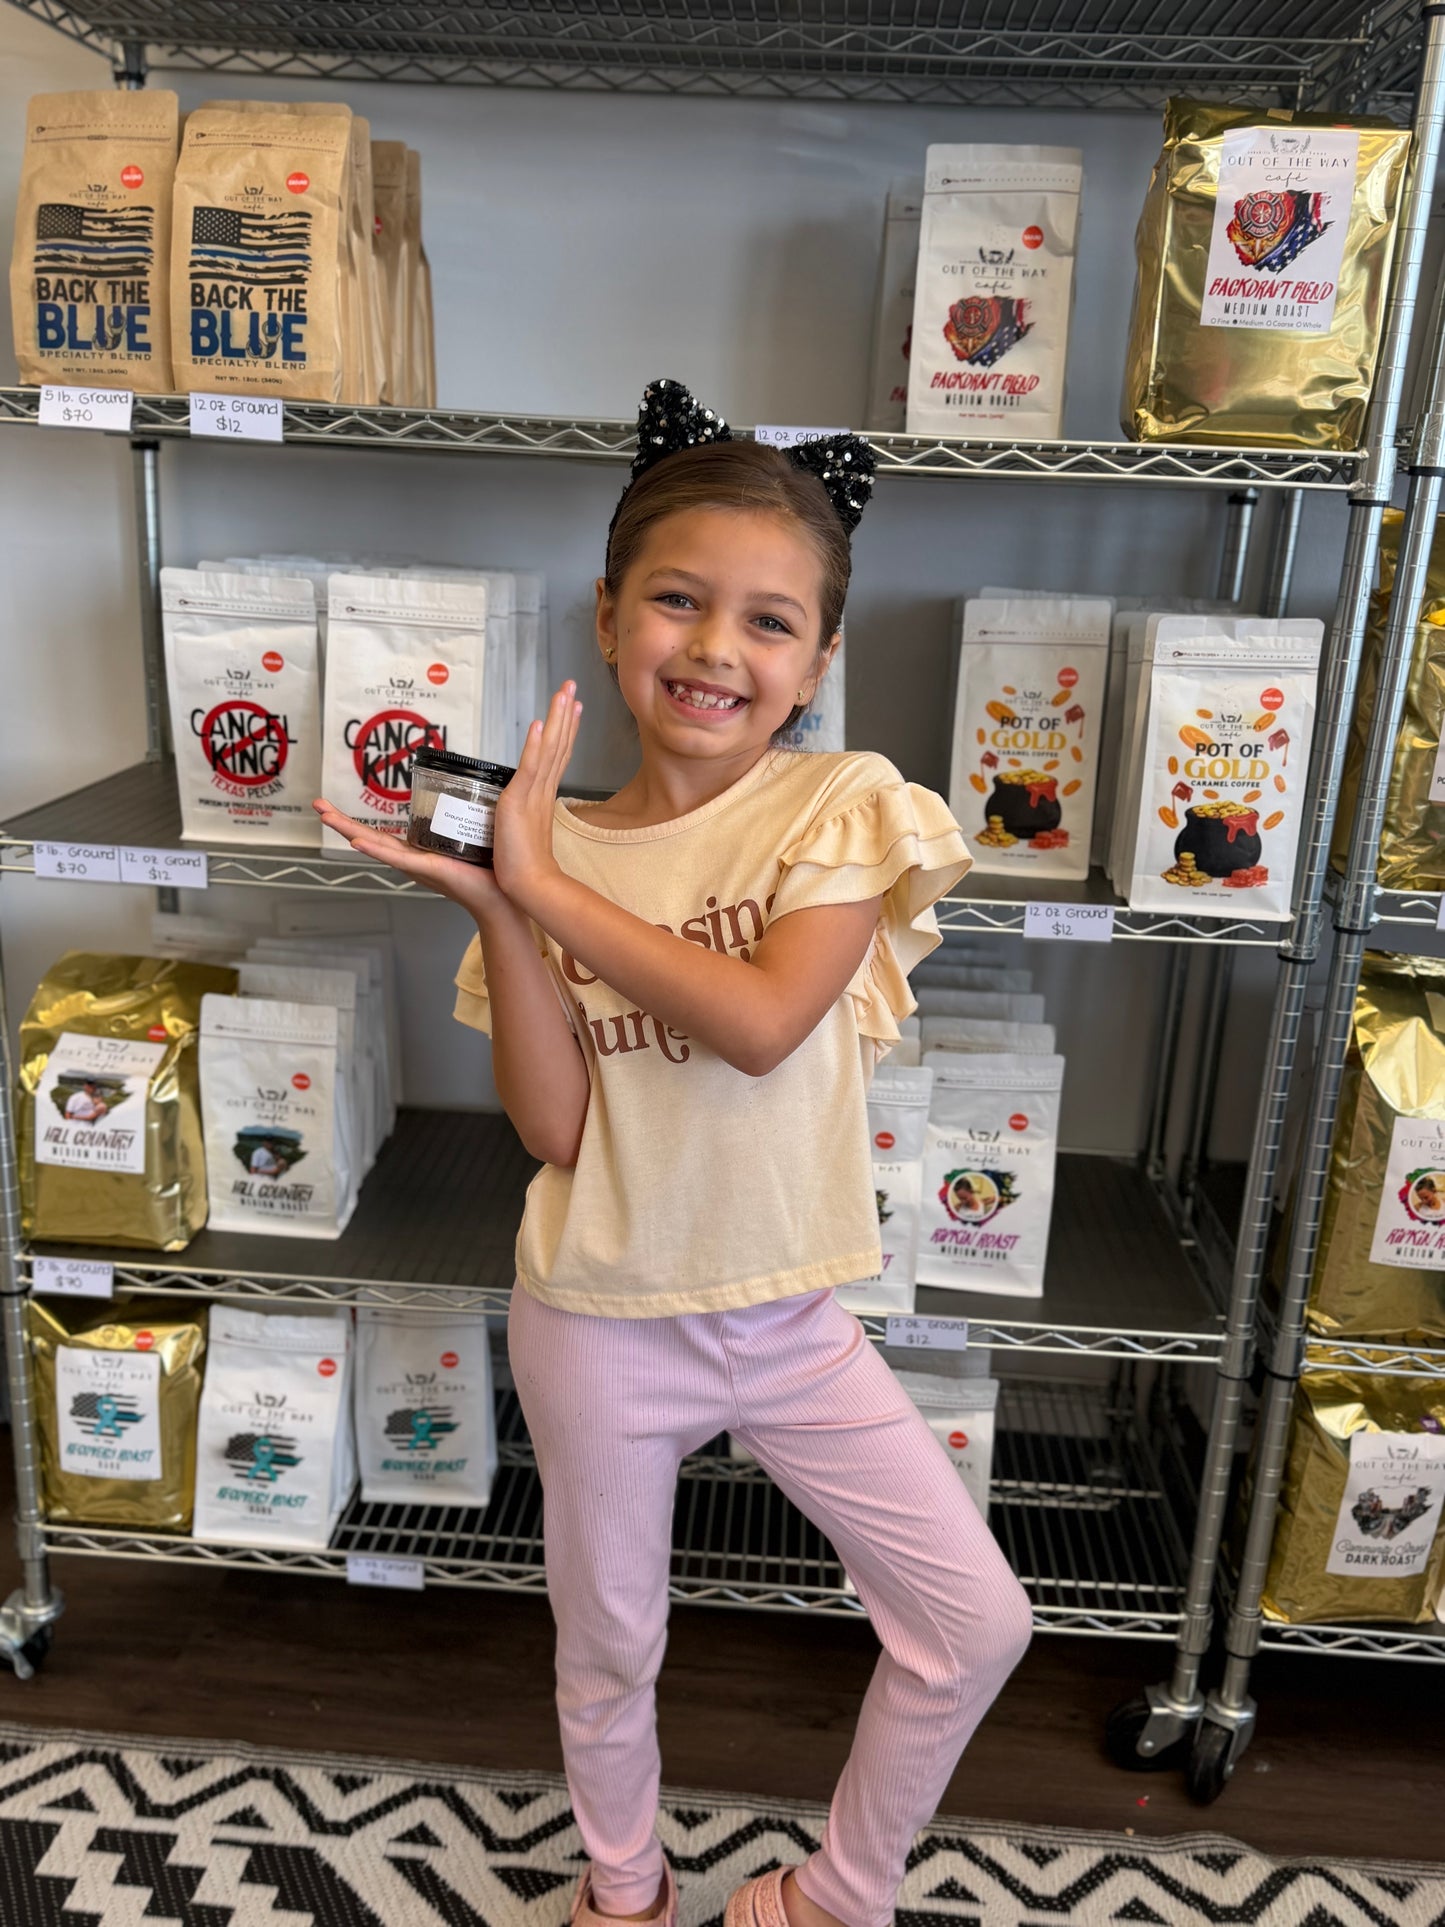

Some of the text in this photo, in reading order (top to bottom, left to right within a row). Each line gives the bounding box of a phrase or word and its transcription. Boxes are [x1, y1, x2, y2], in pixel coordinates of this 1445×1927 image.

[1228, 156, 1350, 168] OUT OF THE WAY
[1266, 172, 1308, 188] café
[942, 264, 1047, 279] OUT OF THE WAY
[36, 277, 150, 304] BACK THE
[191, 283, 307, 313] BACK THE
[1208, 278, 1334, 304] BACKDRAFT BLEND
[1224, 302, 1310, 318] MEDIUM ROAST
[37, 302, 152, 352] BLUE
[1272, 320, 1294, 328] Coarse
[191, 308, 308, 362] BLUE
[39, 351, 151, 361] SPECIALTY BLEND
[192, 357, 306, 370] SPECIALTY BLEND
[1001, 374, 1040, 394] BLEND
[44, 390, 129, 405] 5 lb. Ground
[945, 394, 1020, 406] MEDIUM ROAST
[194, 398, 207, 410] 12
[231, 400, 279, 415] Ground
[62, 408, 92, 422] $70
[216, 416, 243, 433] $12
[759, 429, 770, 440] 12
[190, 708, 298, 744] CANCEL
[1000, 715, 1062, 731] POT OF
[990, 729, 1068, 751] GOLD
[1195, 742, 1264, 758] POT OF
[211, 740, 280, 776] KING
[362, 751, 412, 794] KIN
[1184, 757, 1270, 780] GOLD
[211, 774, 285, 800] TEXAS PECAN
[1190, 780, 1261, 789] CARAMEL COFFEE
[360, 789, 394, 815] TEXAS
[36, 844, 44, 854] 5
[125, 852, 138, 864] 12
[56, 862, 88, 876] $70
[148, 867, 172, 882] $12
[1030, 906, 1040, 917] 12
[1066, 907, 1108, 919] Ground
[1052, 922, 1073, 936] $12
[74, 1128, 138, 1152] COUNTRY
[1401, 1140, 1442, 1150] OUT OF
[976, 1233, 1022, 1251] ROAST
[1396, 1247, 1434, 1258] MEDIUM
[890, 1319, 900, 1328] 12
[906, 1334, 930, 1346] $12
[1344, 1553, 1417, 1566] DARK ROAST
